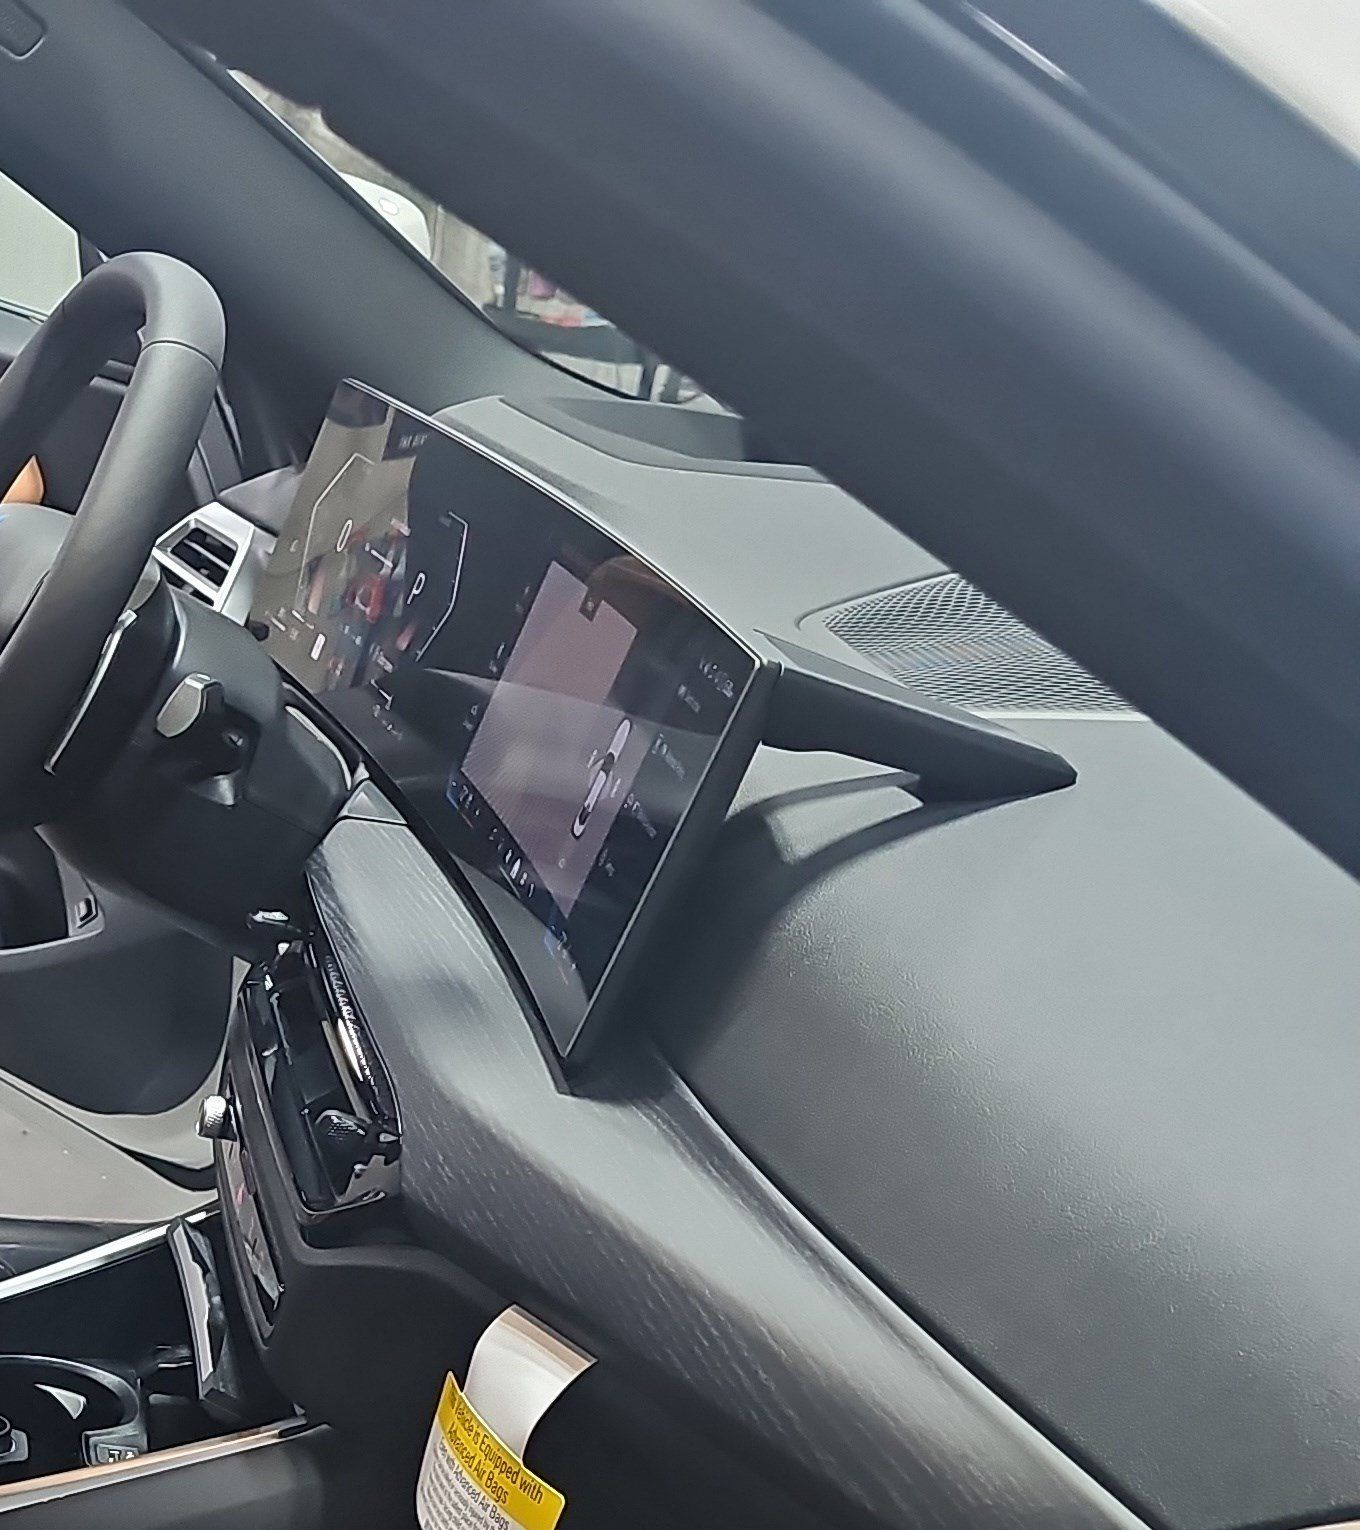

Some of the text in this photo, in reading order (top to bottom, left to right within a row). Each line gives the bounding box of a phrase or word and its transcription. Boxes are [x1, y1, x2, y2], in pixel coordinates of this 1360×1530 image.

[406, 572, 427, 605] P
[473, 1458, 486, 1480] Air
[484, 1470, 510, 1505] Bags
[478, 1433, 521, 1485] Equipped
[519, 1475, 544, 1505] with
[478, 1497, 491, 1513] Air
